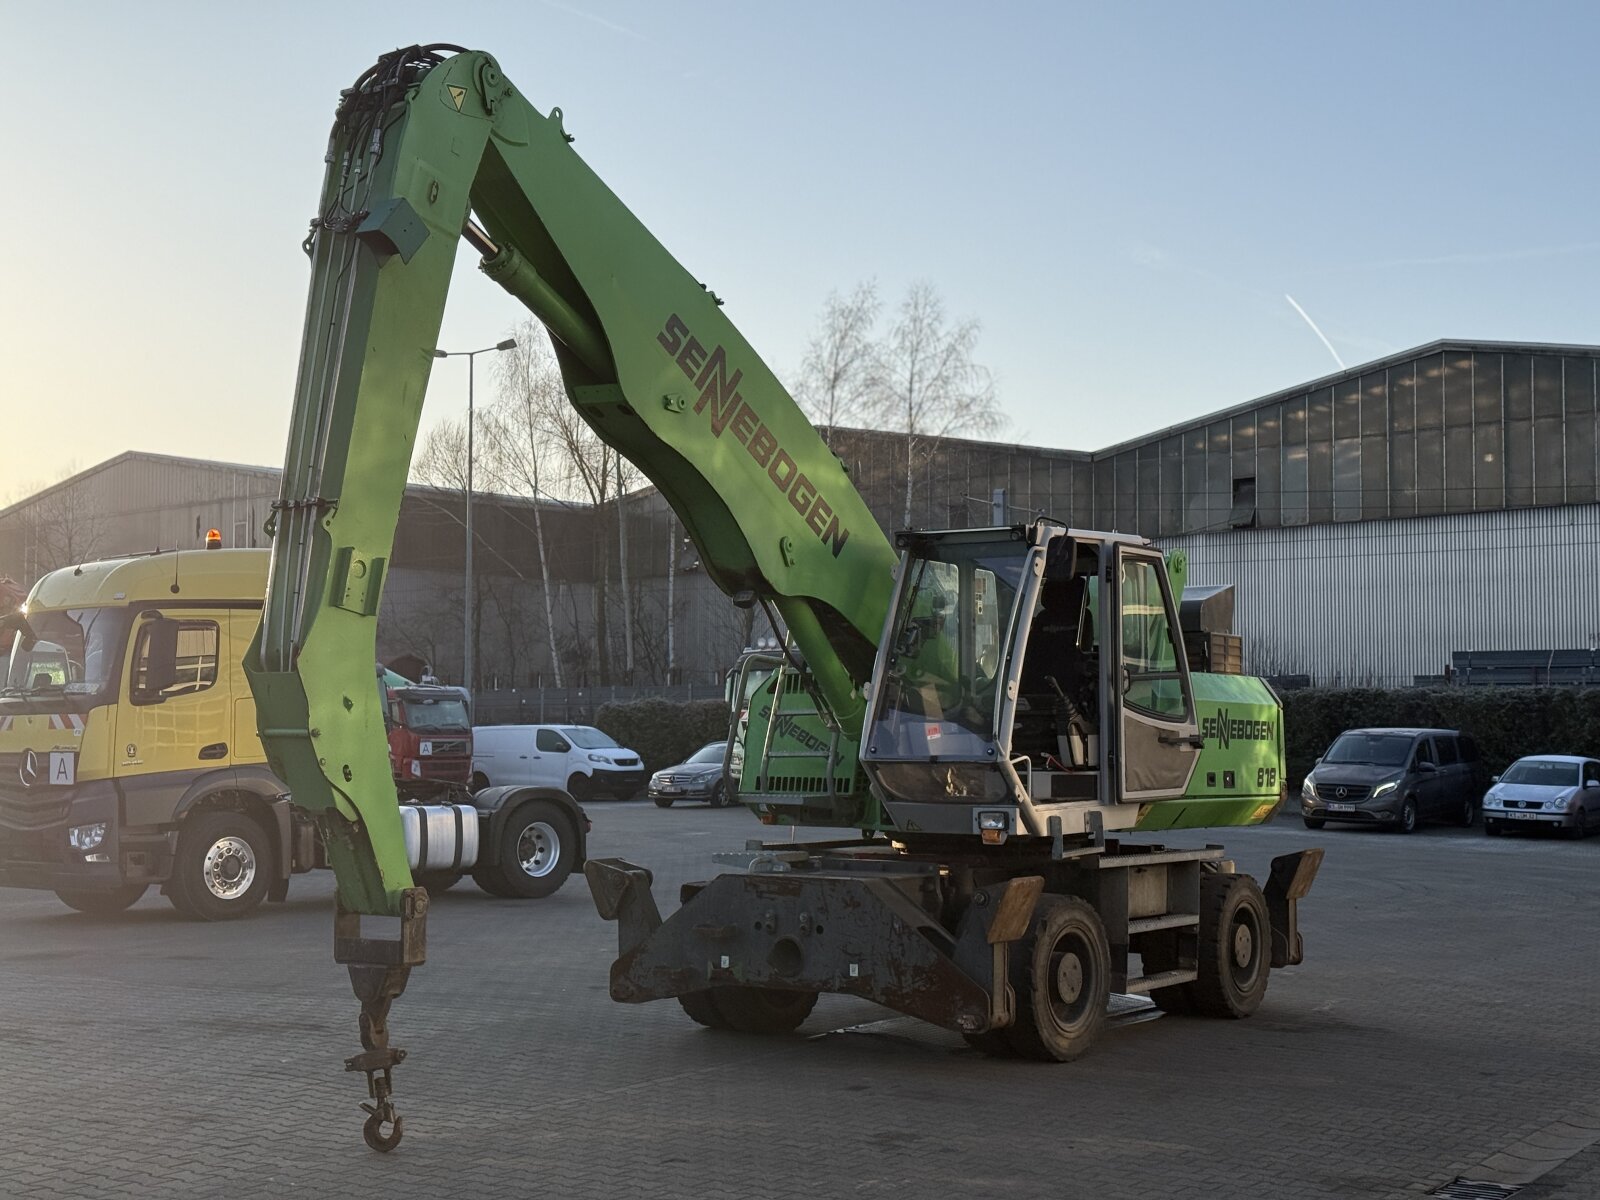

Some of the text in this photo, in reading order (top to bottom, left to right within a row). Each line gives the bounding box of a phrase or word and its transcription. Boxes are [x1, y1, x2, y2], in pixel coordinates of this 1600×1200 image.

[657, 313, 850, 559] SENNEBOGEN
[1202, 708, 1274, 749] SENNEBOGEN
[422, 744, 430, 753] A
[57, 757, 68, 780] A
[1257, 768, 1276, 787] 818
